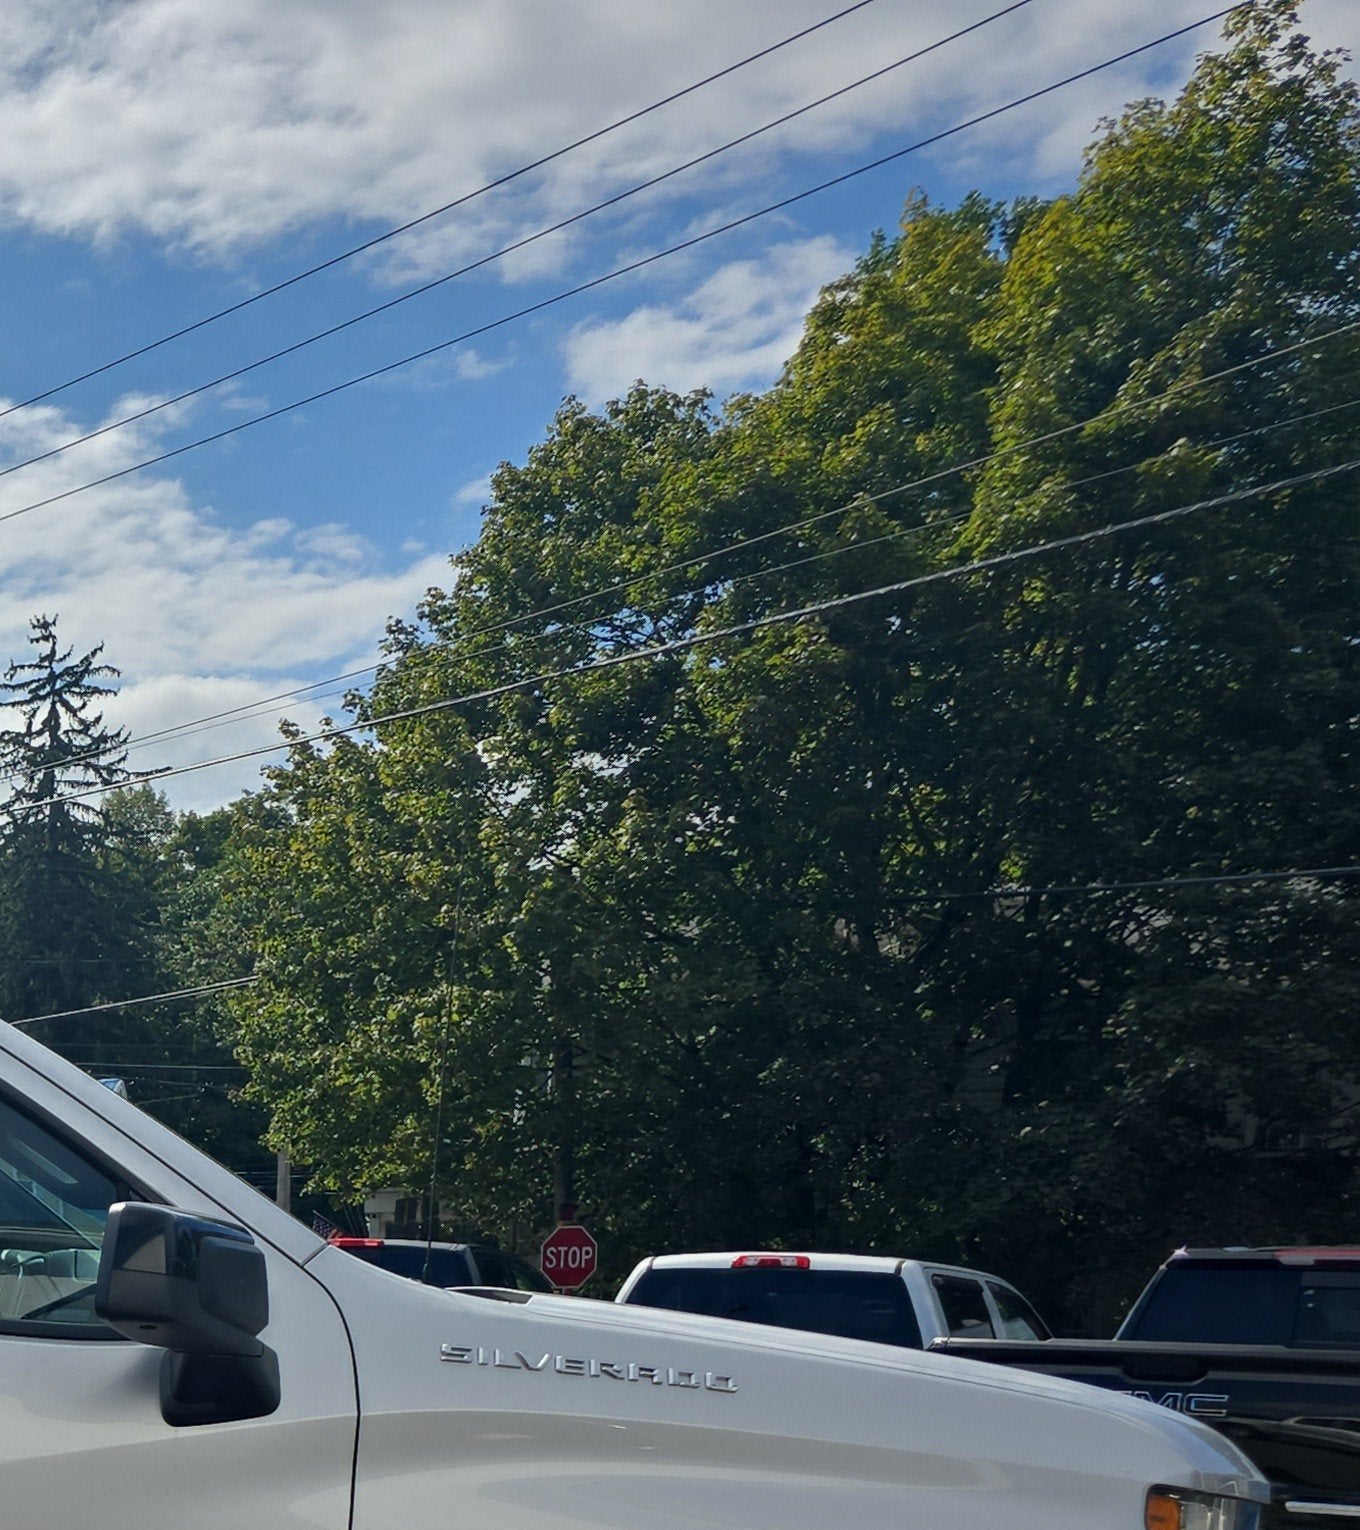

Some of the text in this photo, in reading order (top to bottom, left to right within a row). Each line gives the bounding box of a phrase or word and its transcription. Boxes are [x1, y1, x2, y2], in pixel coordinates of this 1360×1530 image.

[545, 1246, 593, 1269] STOP
[440, 1342, 739, 1393] SILVERADO
[1116, 1390, 1230, 1417] MC
